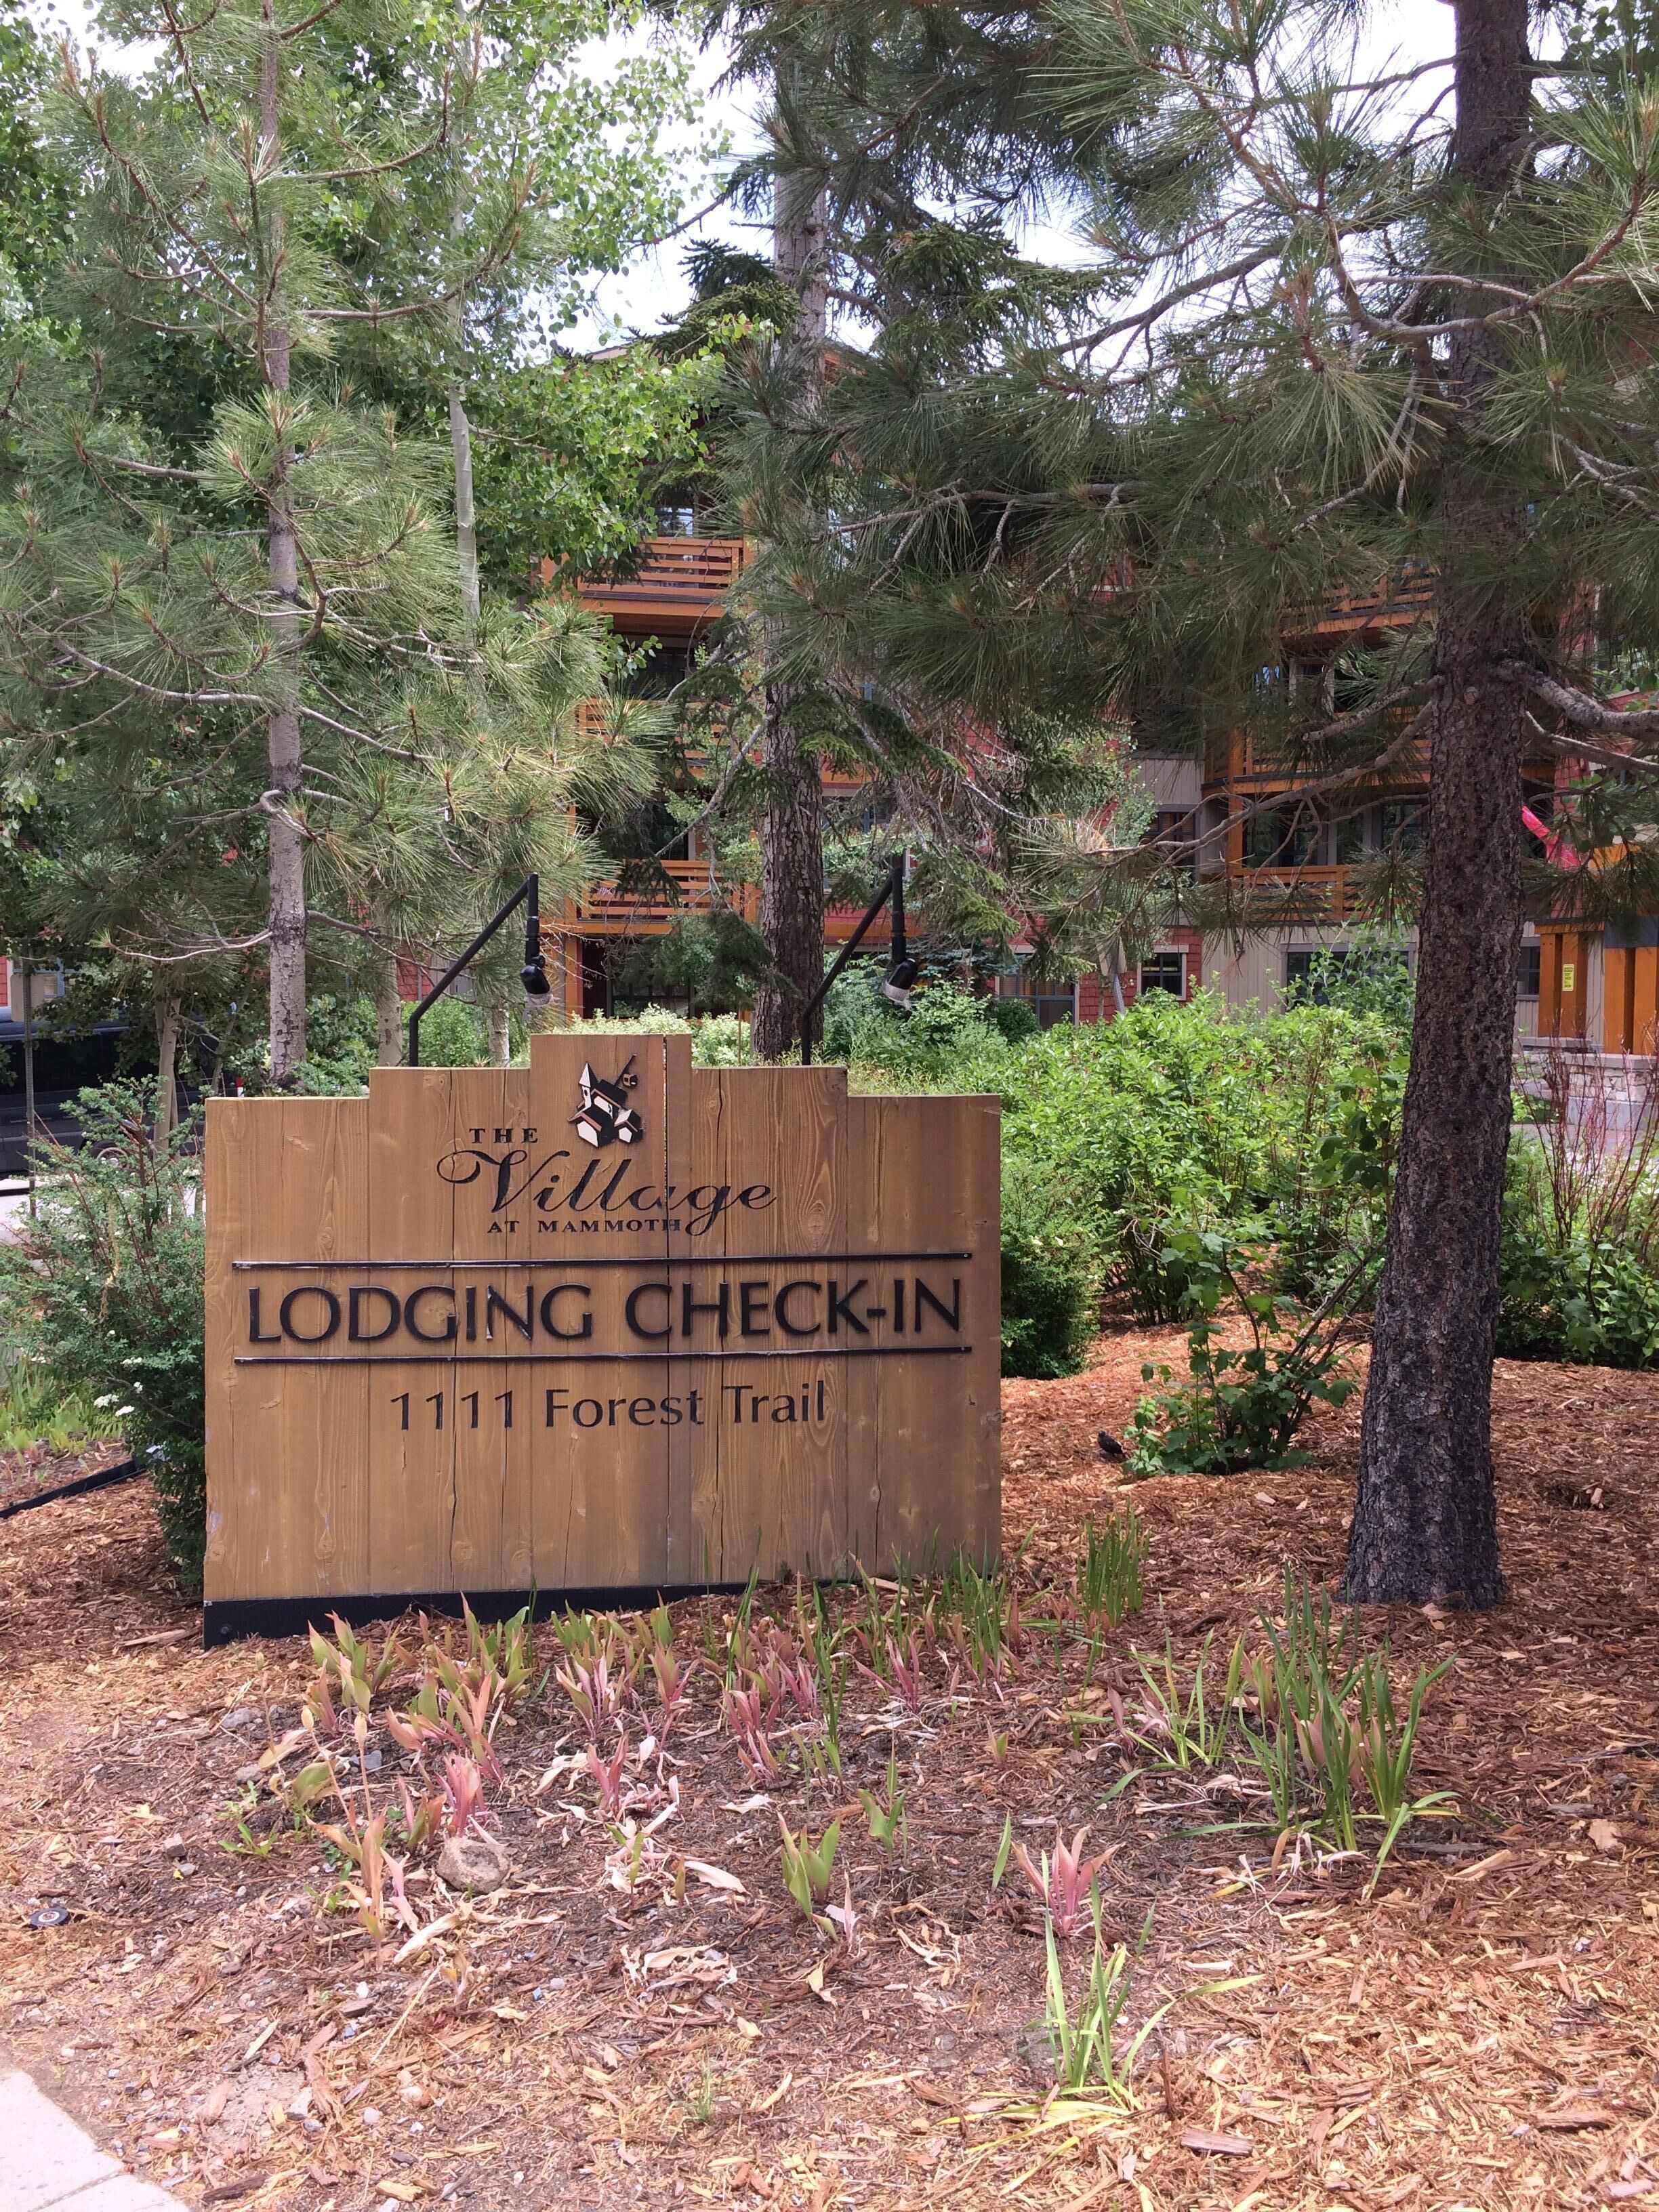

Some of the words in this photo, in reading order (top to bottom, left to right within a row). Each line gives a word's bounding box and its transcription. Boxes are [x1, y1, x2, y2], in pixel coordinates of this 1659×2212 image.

[469, 1128, 539, 1144] THE
[436, 1149, 777, 1236] Village
[487, 1221, 520, 1234] AT
[538, 1219, 682, 1233] MAMMOTH
[248, 1284, 594, 1342] LODGING
[625, 1278, 961, 1338] CHECK-IN
[390, 1390, 514, 1431] 1111
[545, 1388, 705, 1428] Forest
[723, 1380, 827, 1422] Trail
